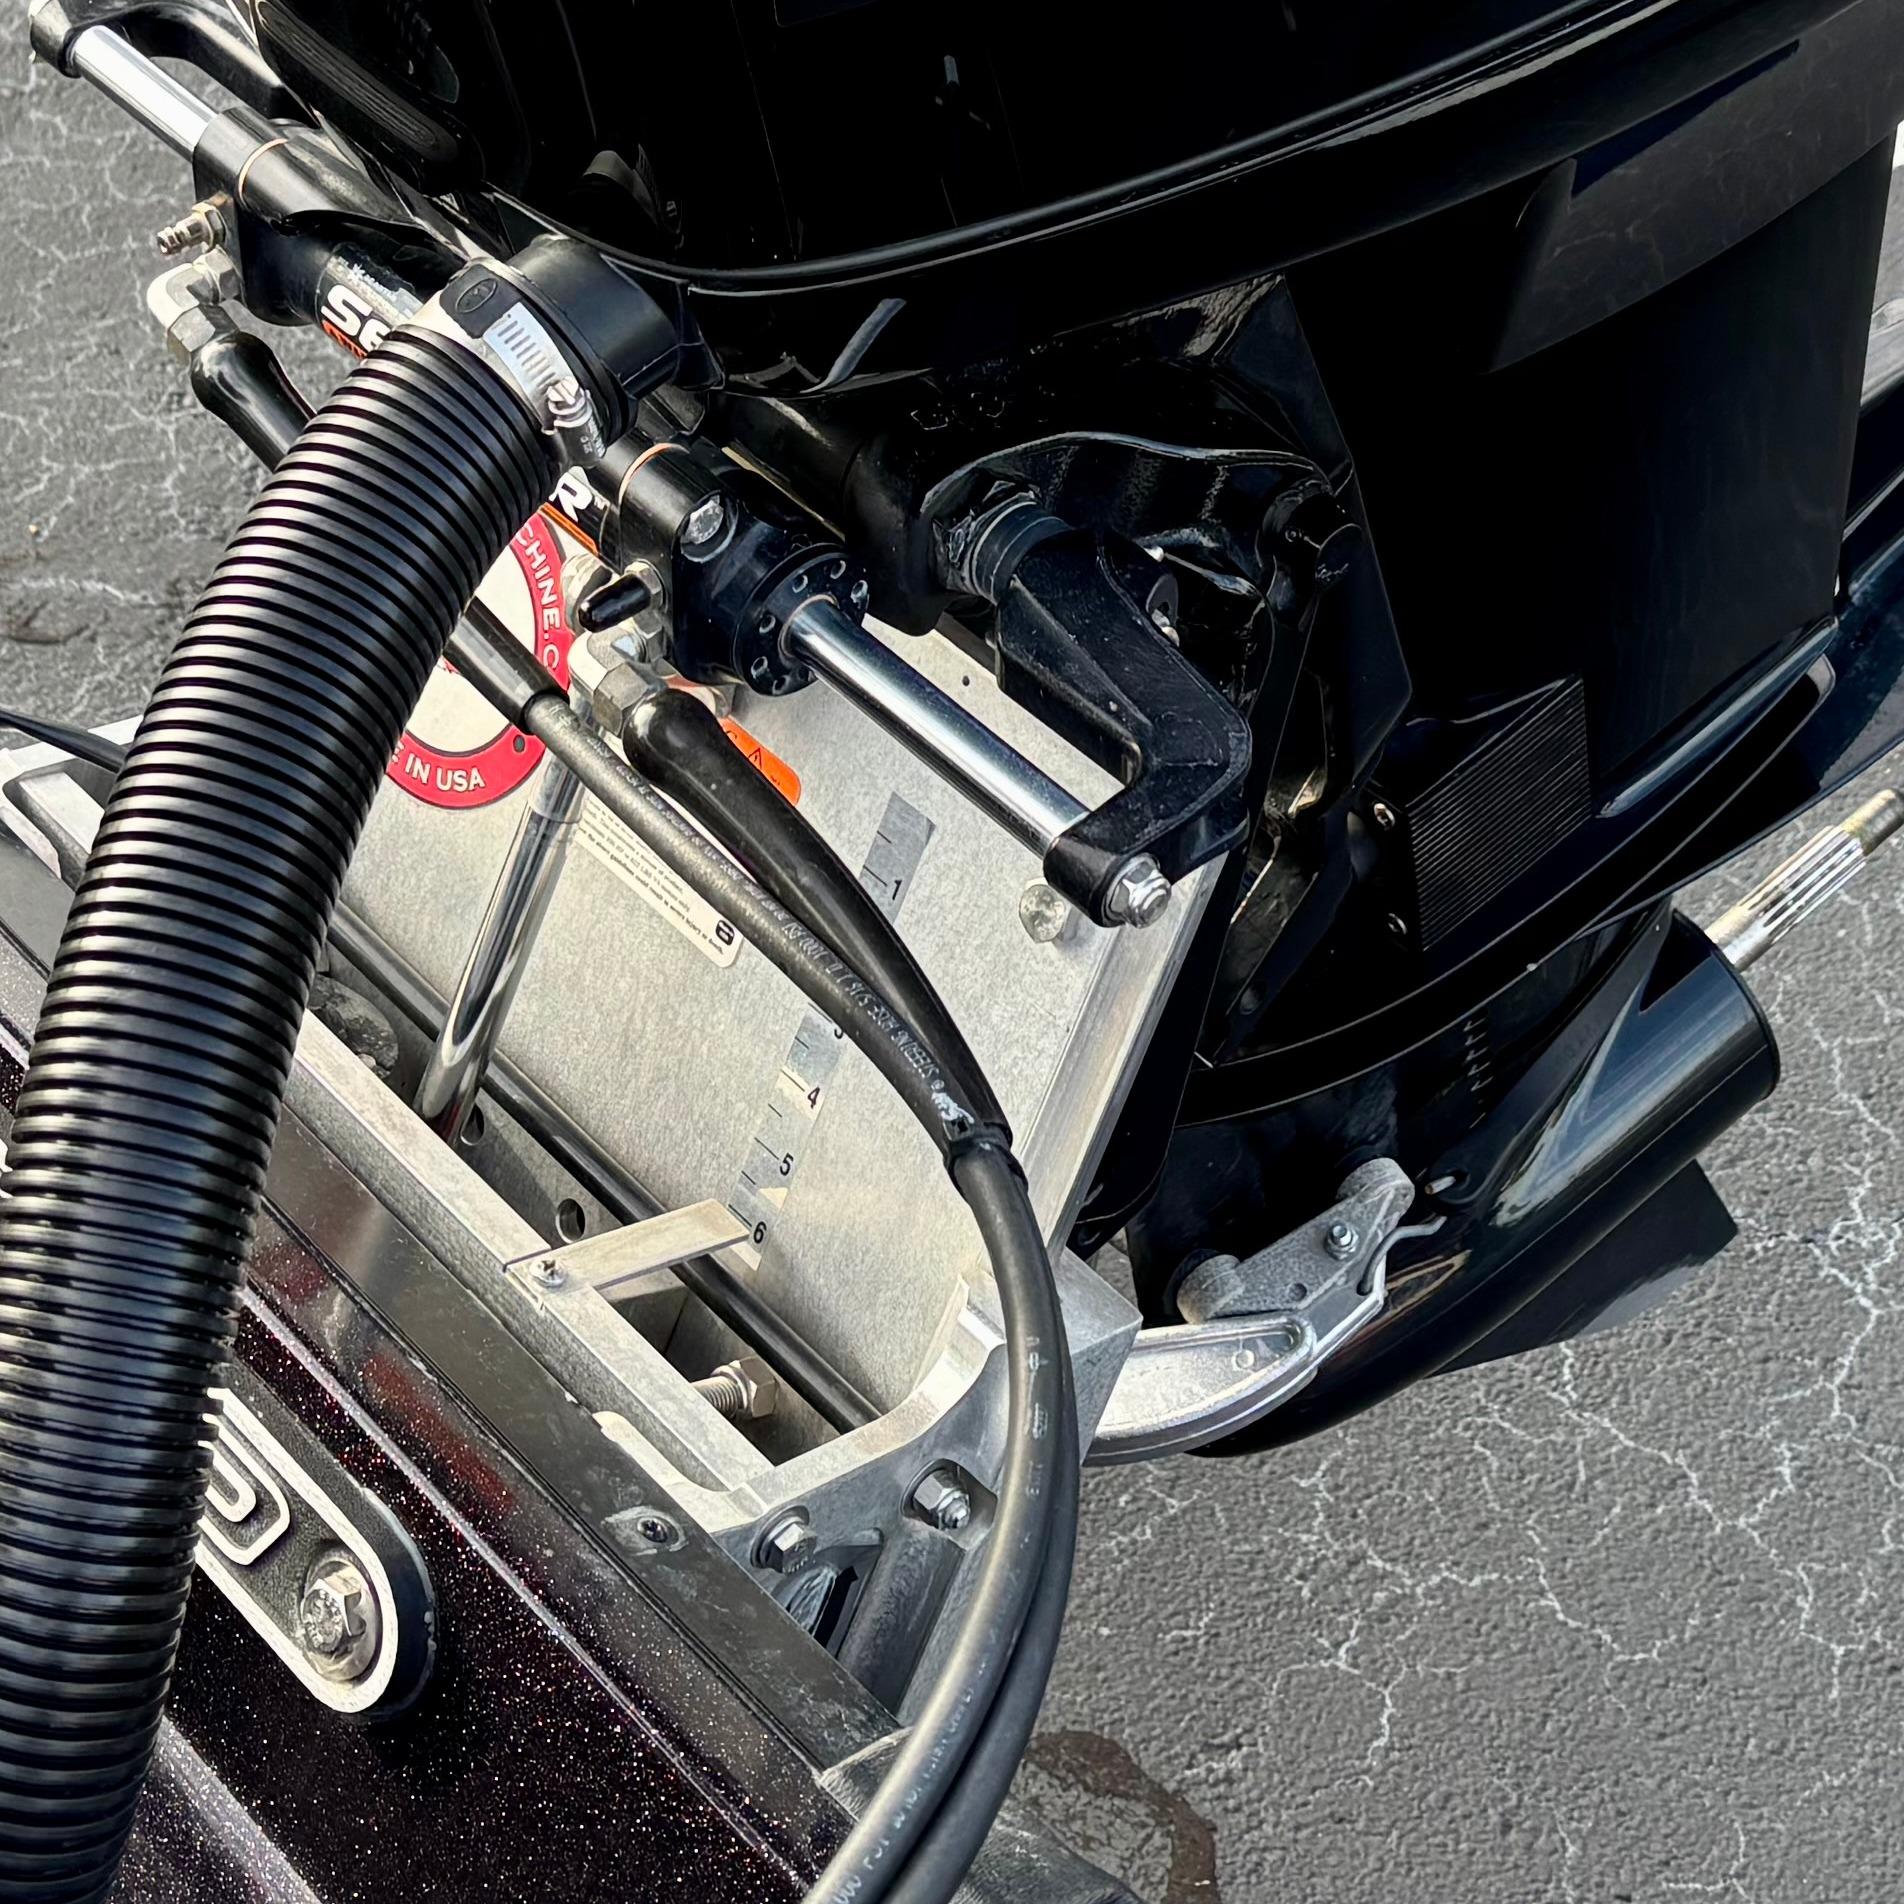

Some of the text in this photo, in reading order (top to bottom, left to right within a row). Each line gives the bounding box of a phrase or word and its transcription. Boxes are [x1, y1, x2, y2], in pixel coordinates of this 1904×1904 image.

[404, 754, 487, 793] IN USA
[891, 878, 903, 901] 1
[807, 1086, 821, 1110] 4
[779, 1152, 794, 1177] 5
[752, 1220, 767, 1245] 6
